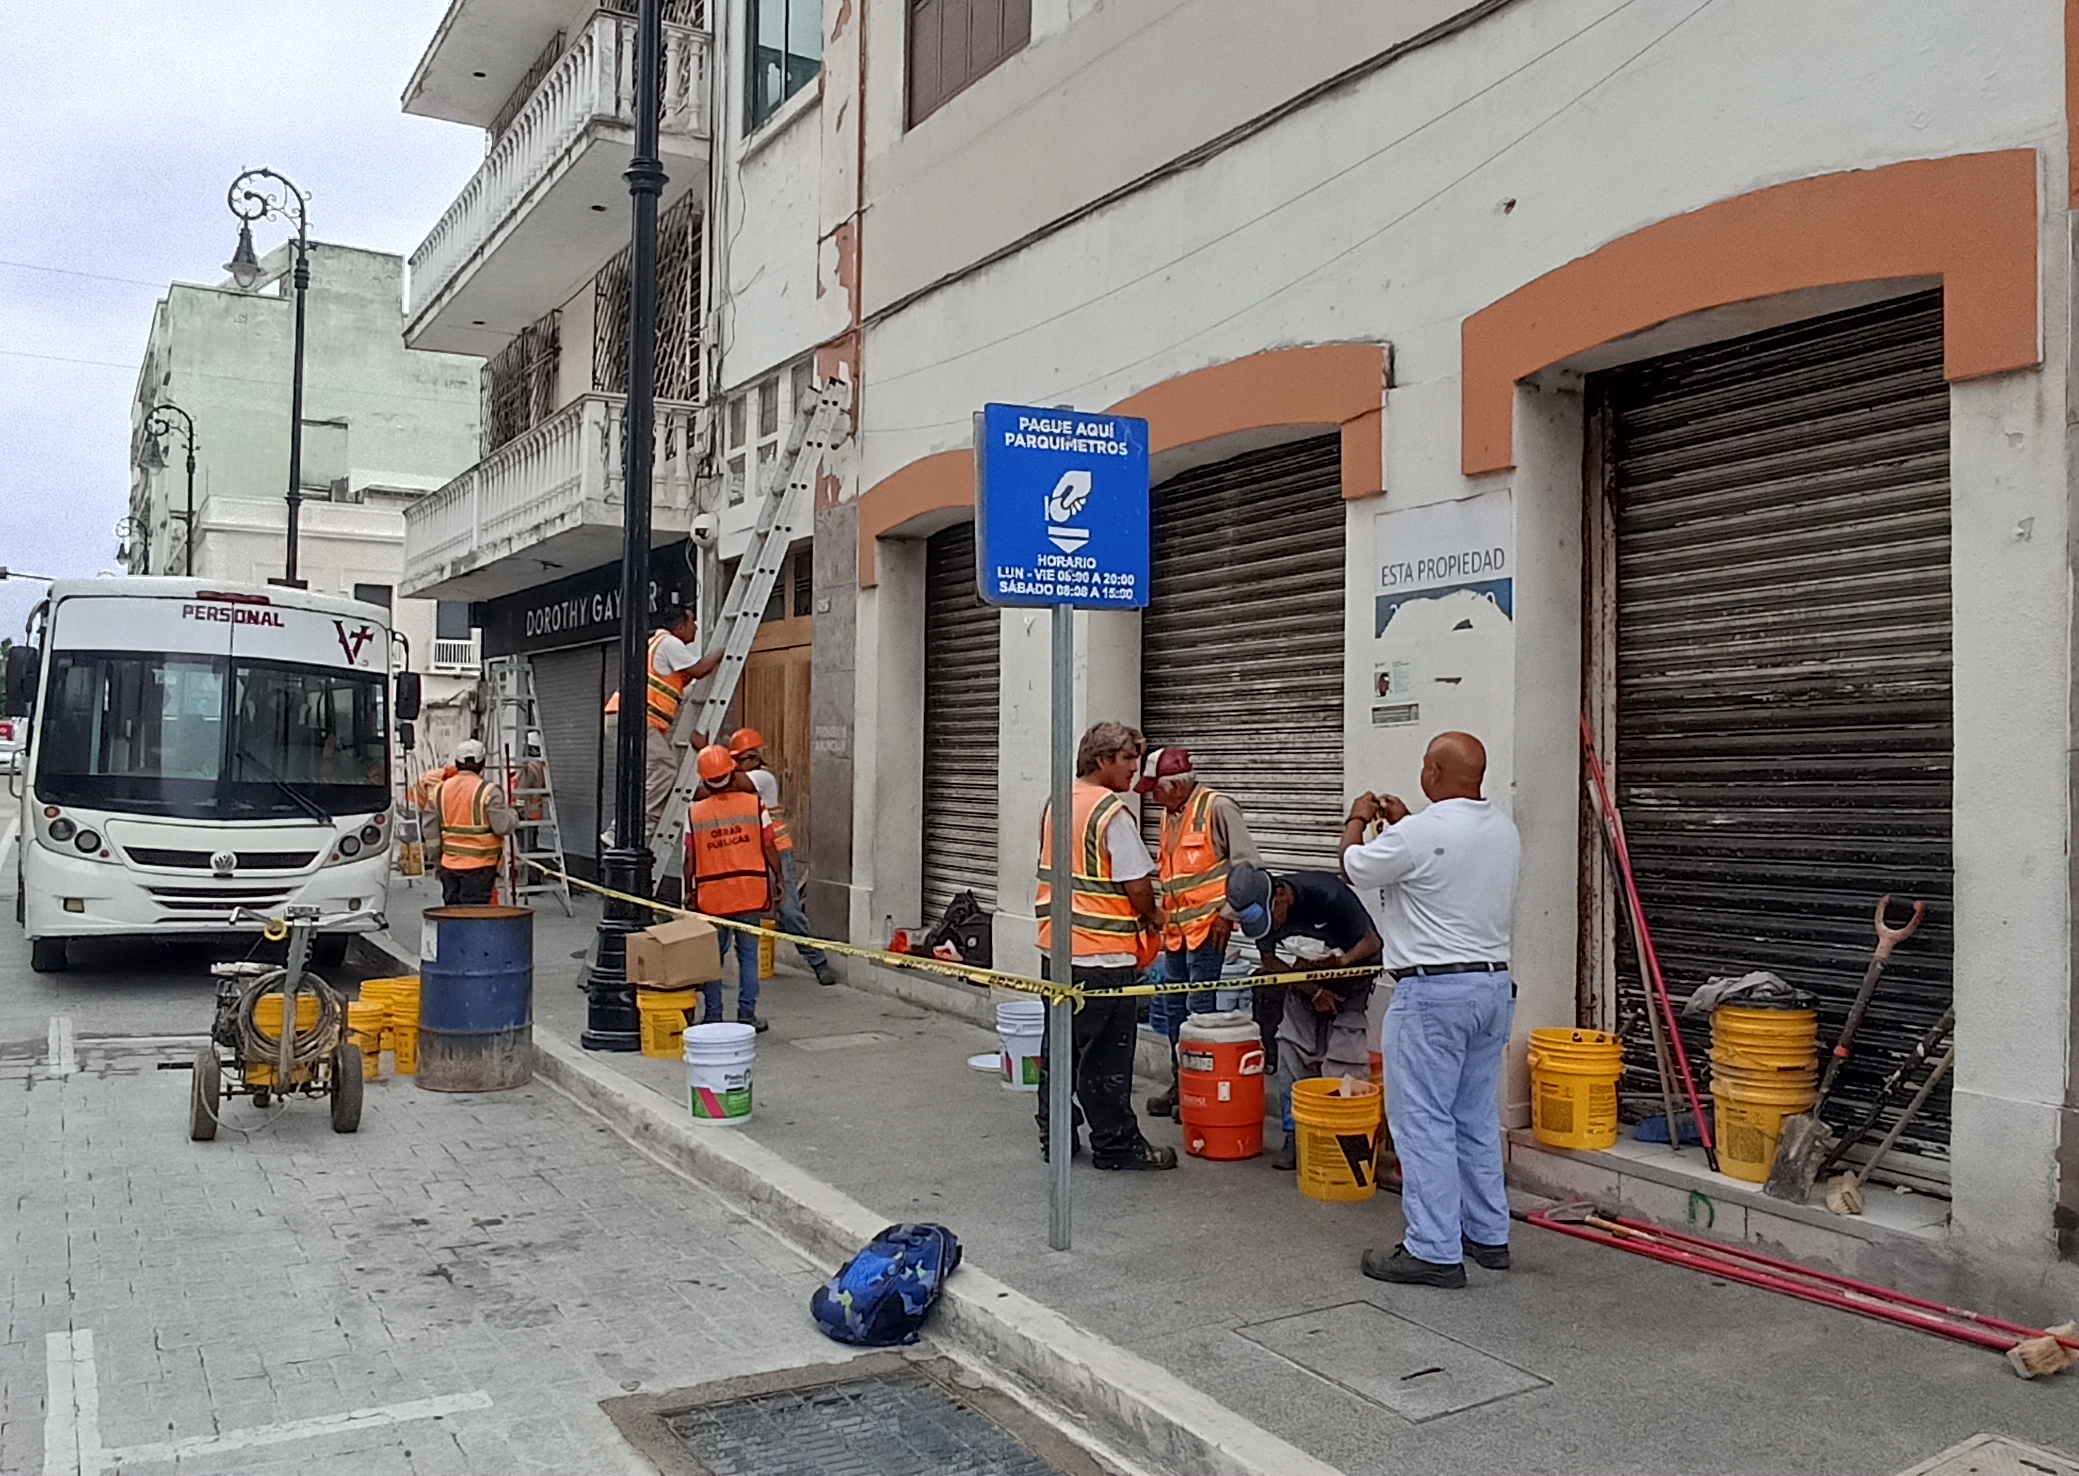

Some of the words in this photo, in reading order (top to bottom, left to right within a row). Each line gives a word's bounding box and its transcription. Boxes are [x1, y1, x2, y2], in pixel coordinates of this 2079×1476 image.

[1019, 416, 1072, 435] PAGUE
[1075, 421, 1115, 439] AQUÍ
[1037, 554, 1097, 570] HORARIO
[1381, 562, 1413, 587] ESTA
[1417, 547, 1505, 580] PROPIEDAD
[997, 566, 1024, 580] LUN
[1034, 568, 1055, 582] VIE
[1091, 572, 1102, 585] A
[1103, 573, 1135, 586] 20:00
[999, 579, 1054, 596] SÁBADO
[1089, 586, 1100, 599] A
[182, 604, 285, 628] PERSONAL
[526, 596, 588, 637] DOROTHY
[592, 580, 658, 623] GAYR
[710, 824, 742, 839] OBRAS
